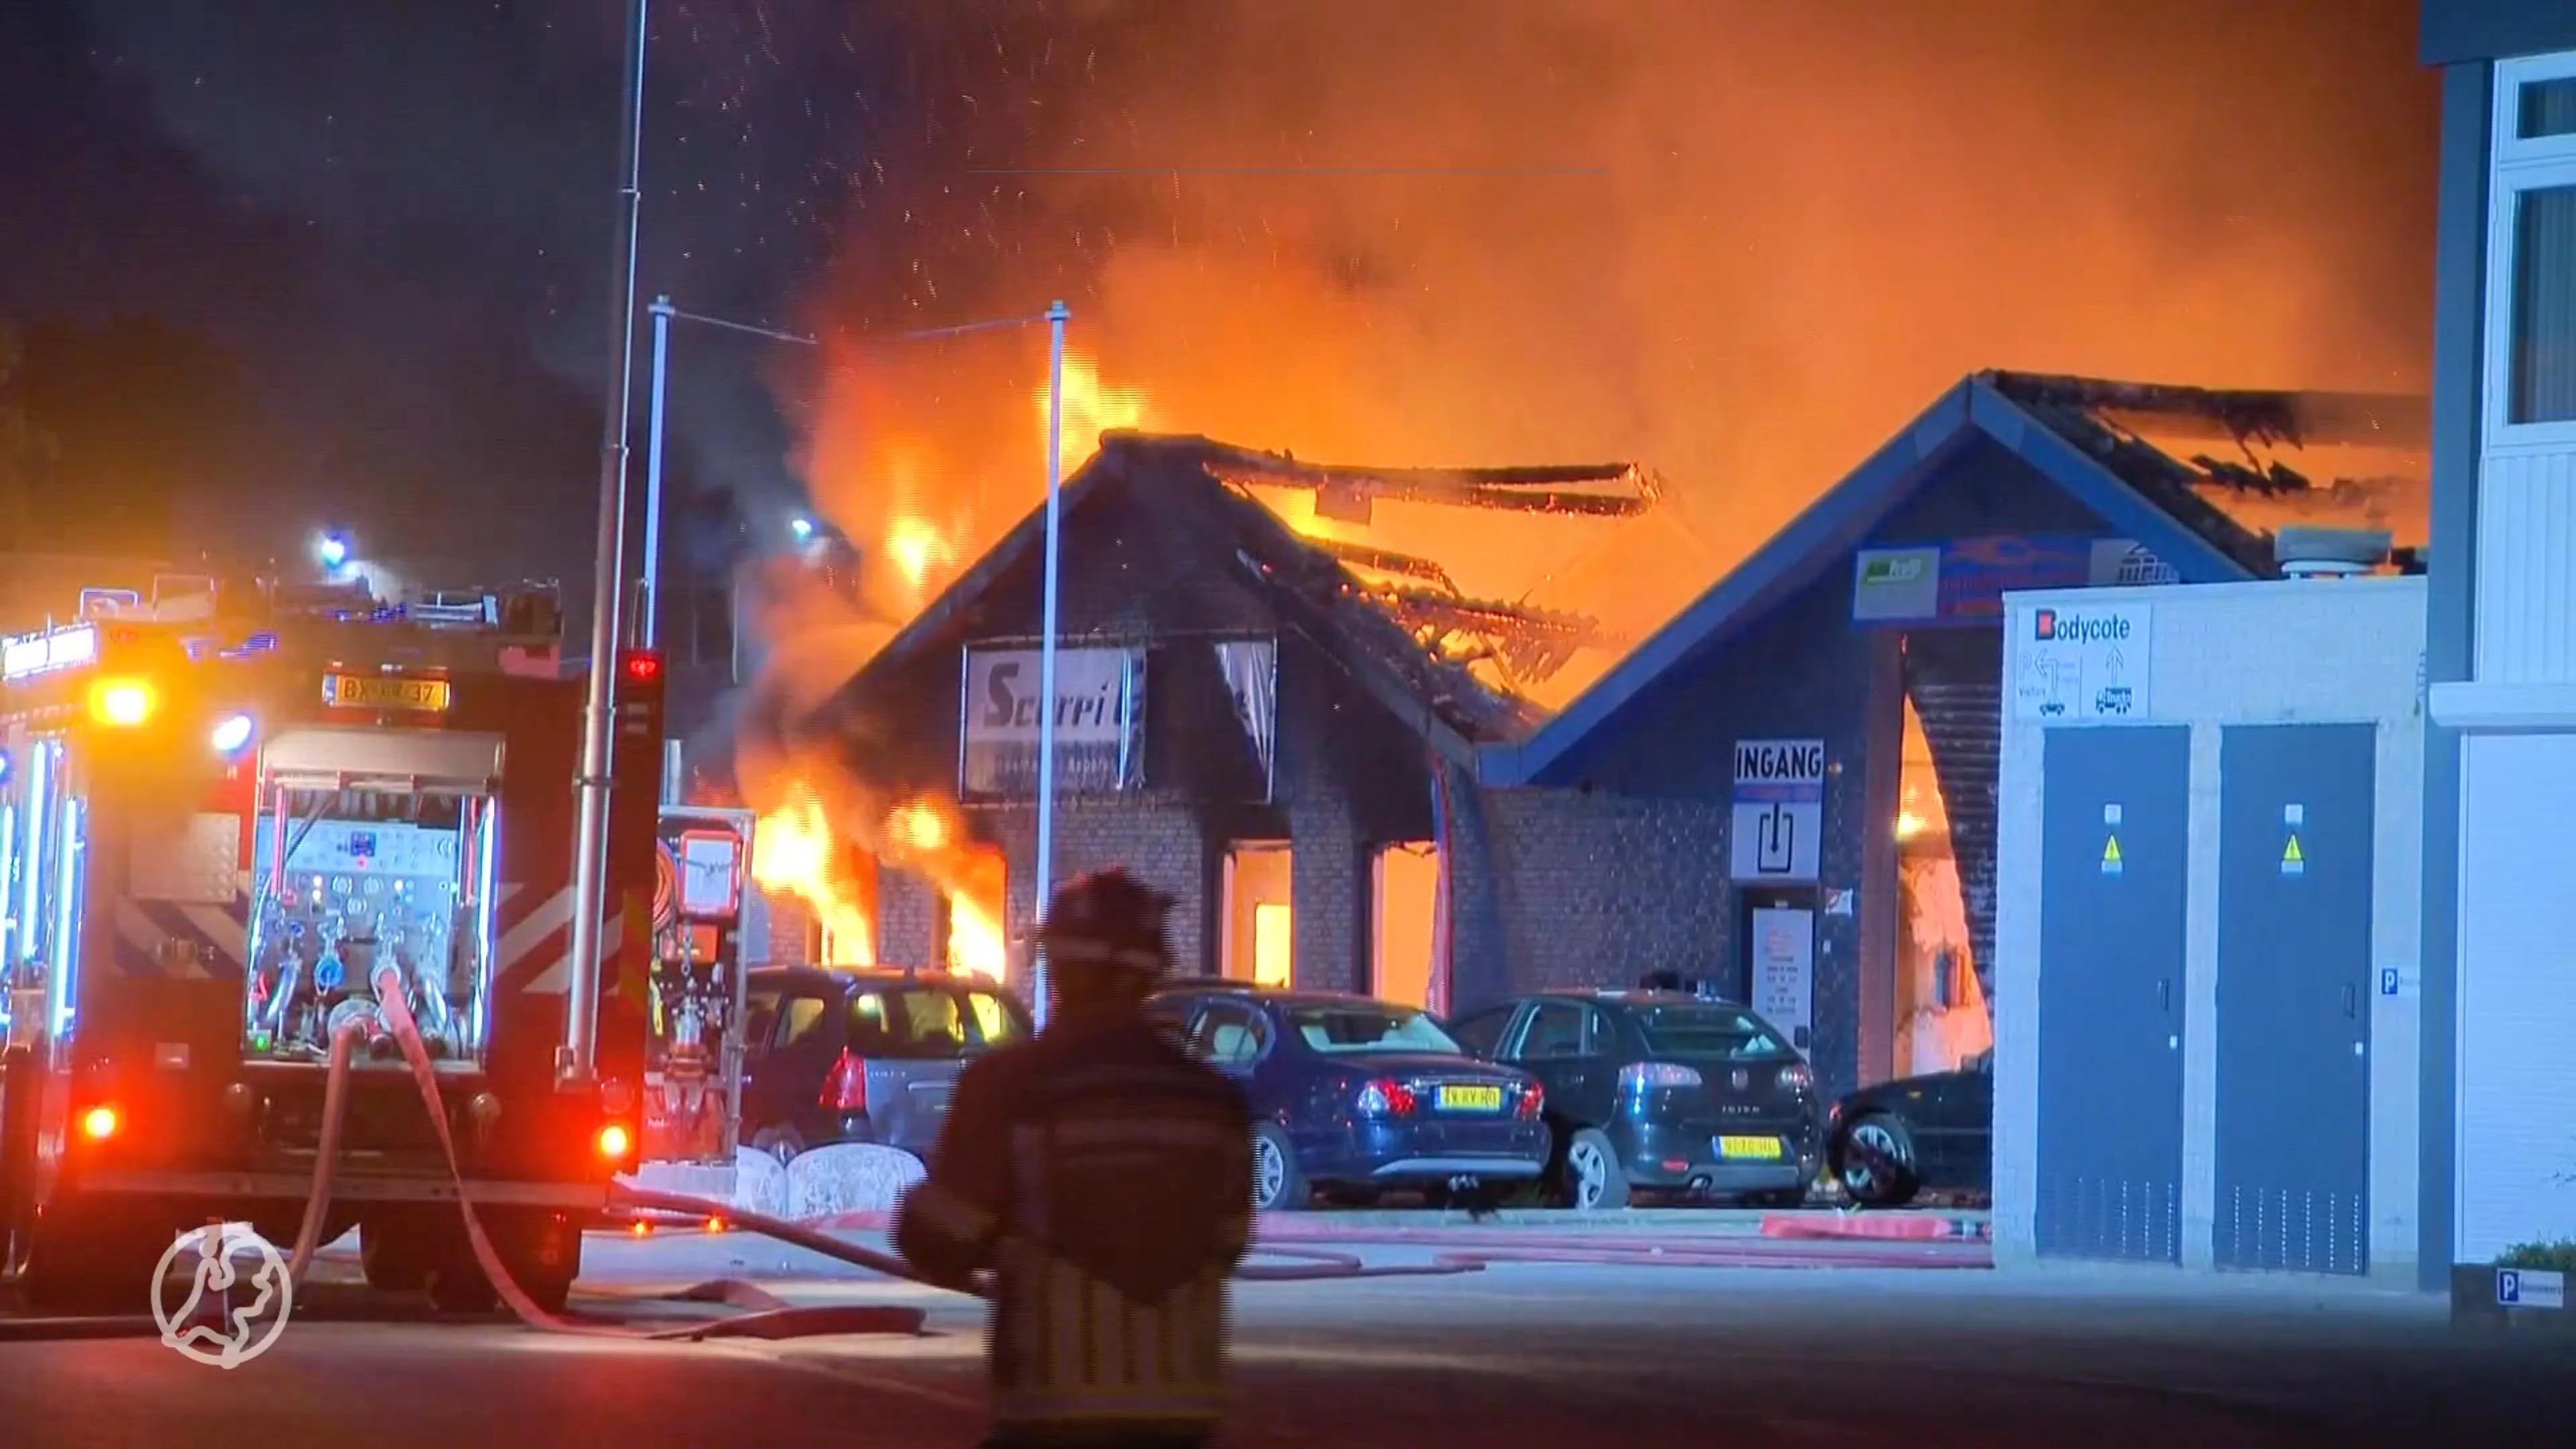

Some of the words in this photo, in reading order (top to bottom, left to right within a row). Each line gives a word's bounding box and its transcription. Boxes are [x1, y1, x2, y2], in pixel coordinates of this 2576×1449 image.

[2035, 608, 2131, 645] Bodycote
[1736, 745, 1821, 778] INGANG
[2504, 1274, 2516, 1299] P
